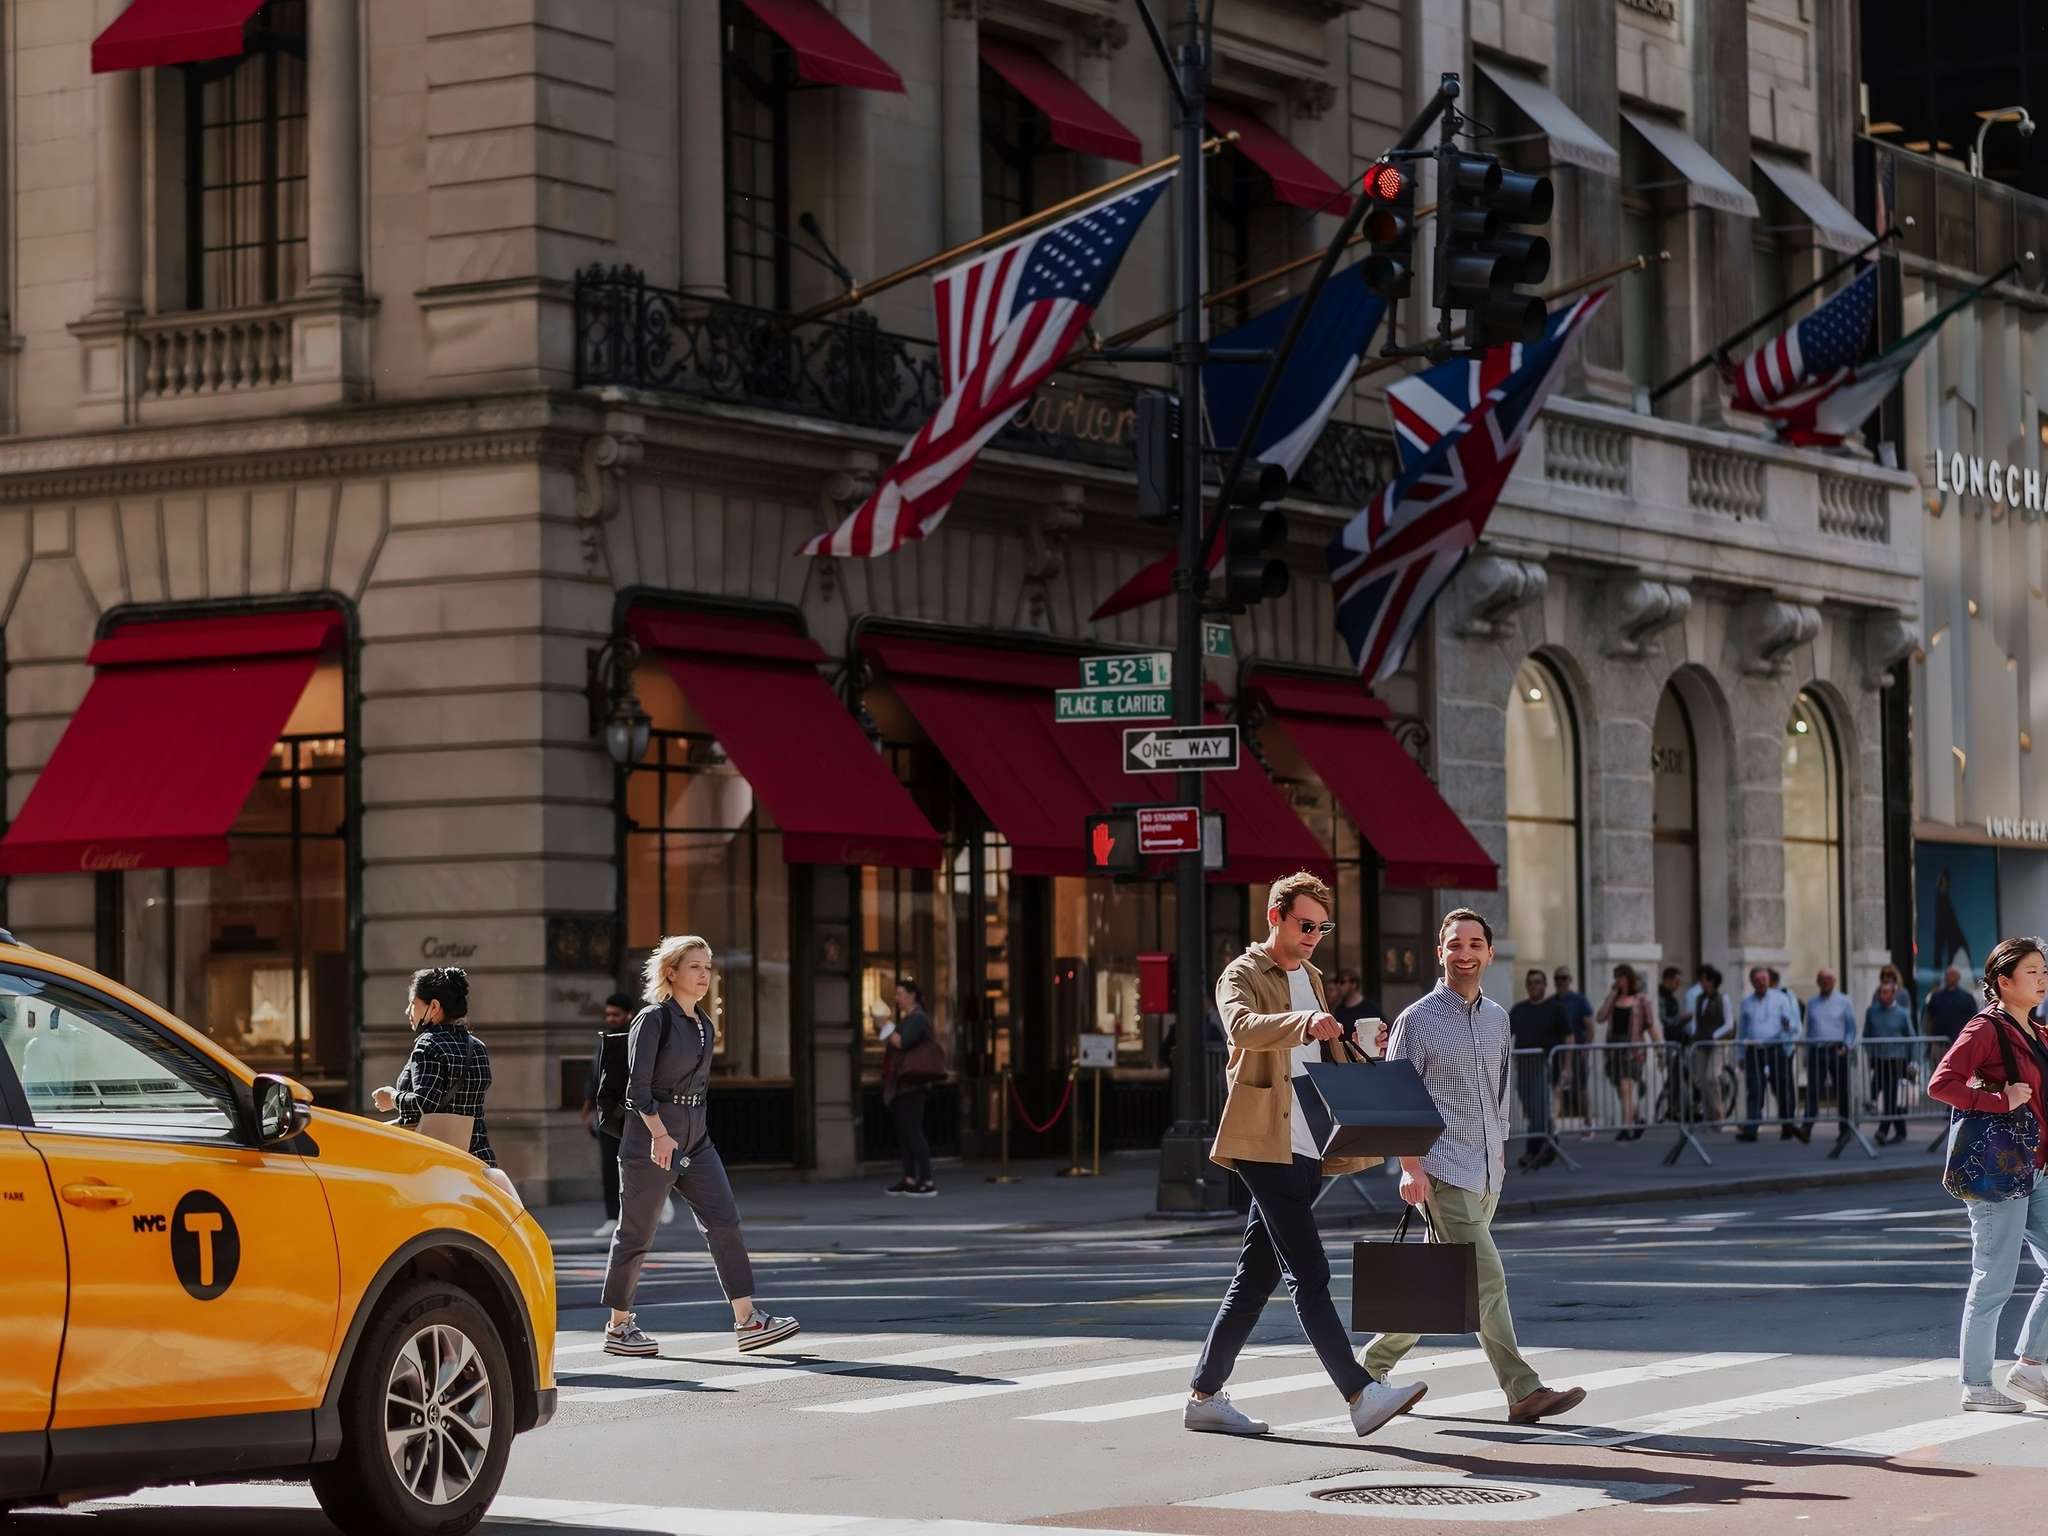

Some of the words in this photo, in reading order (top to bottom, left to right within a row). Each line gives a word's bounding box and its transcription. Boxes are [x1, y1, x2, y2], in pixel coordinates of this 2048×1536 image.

[1084, 661, 1099, 686] E
[1107, 660, 1138, 685] 52
[1060, 696, 1097, 715] PLACE
[1117, 694, 1166, 714] CARTIER
[1142, 741, 1173, 758] ONE
[1188, 740, 1222, 757] WAY
[1142, 813, 1153, 822] NO
[1154, 812, 1189, 822] STANDING
[420, 936, 477, 959] Cartier
[133, 1215, 166, 1233] NYC
[184, 1212, 223, 1287] T
